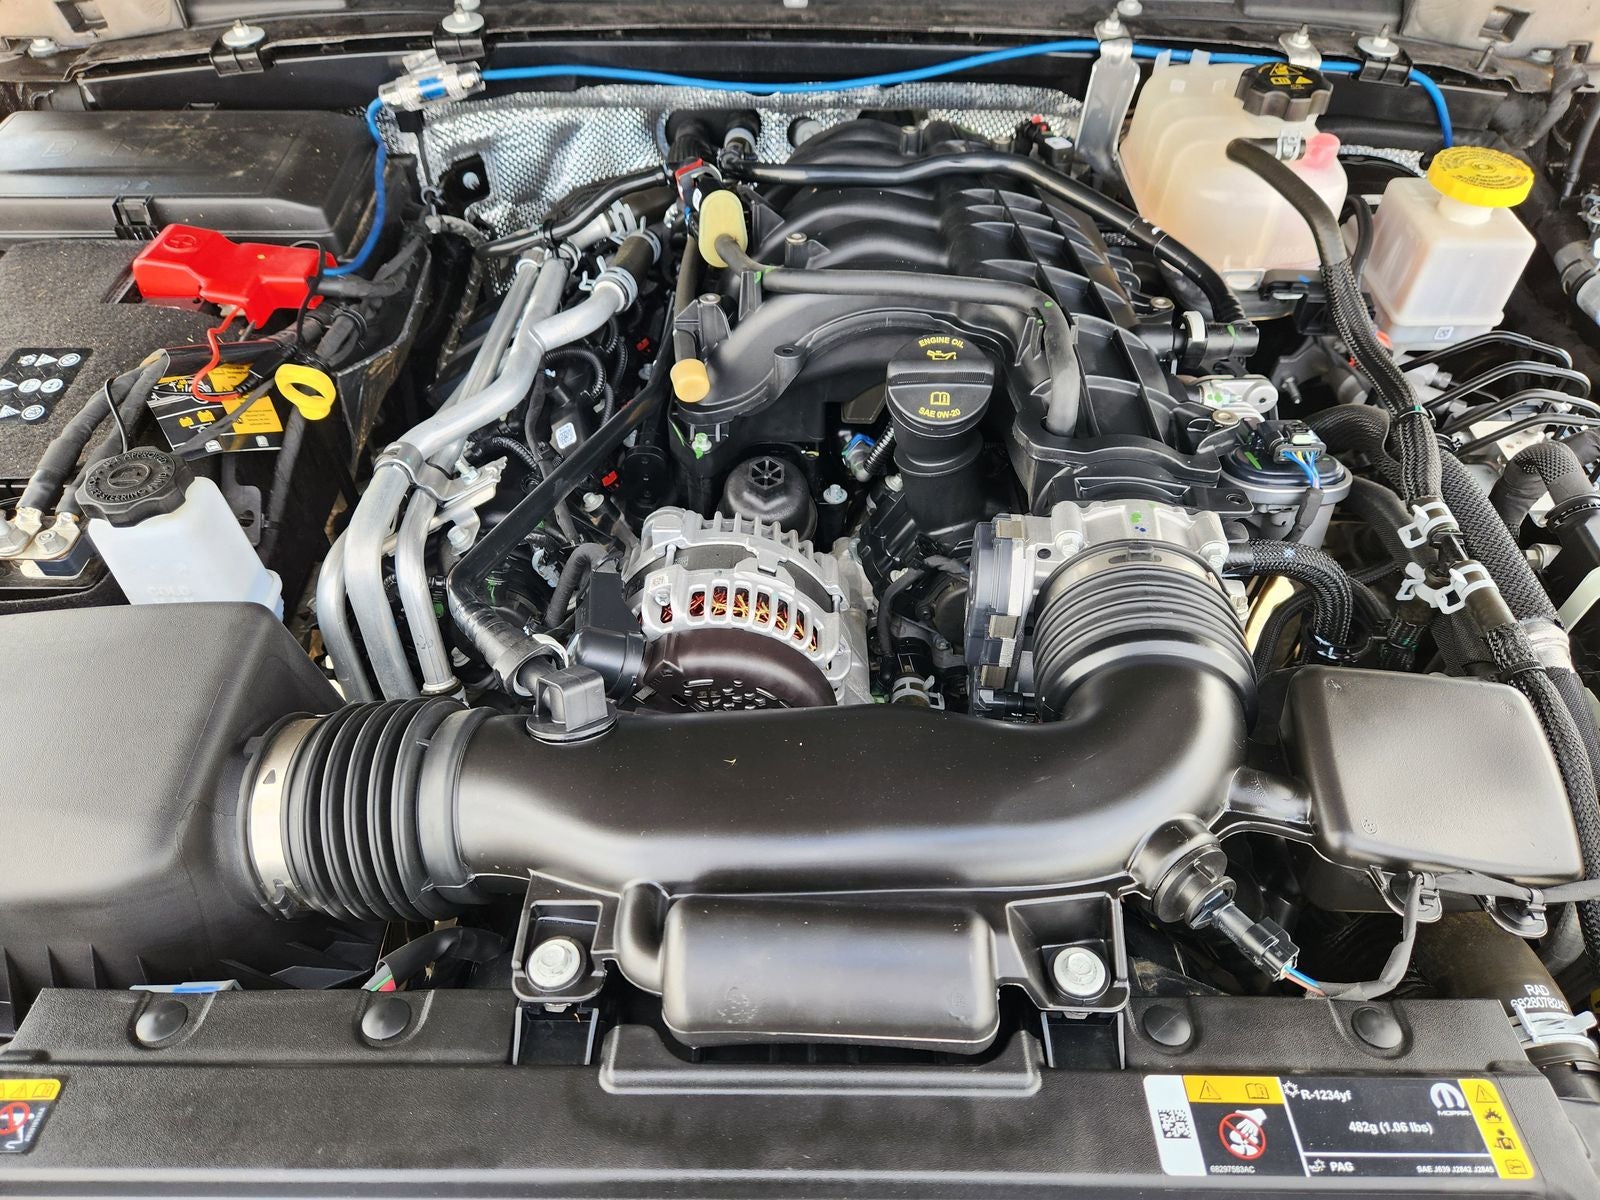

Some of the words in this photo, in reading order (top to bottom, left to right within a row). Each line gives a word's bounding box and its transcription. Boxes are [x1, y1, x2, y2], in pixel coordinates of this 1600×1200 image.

[918, 336, 950, 347] ENGINE
[951, 338, 965, 349] OIL
[918, 407, 936, 417] SAE
[936, 408, 961, 418] 0W-20
[1524, 984, 1550, 996] RAD
[1300, 1089, 1352, 1103] R-1234yf
[1349, 1121, 1379, 1135] 482g
[1379, 1121, 1409, 1135] (1.06
[1409, 1121, 1434, 1135] lbs)
[1329, 1161, 1355, 1172] PAG
[1416, 1165, 1433, 1173] SAE
